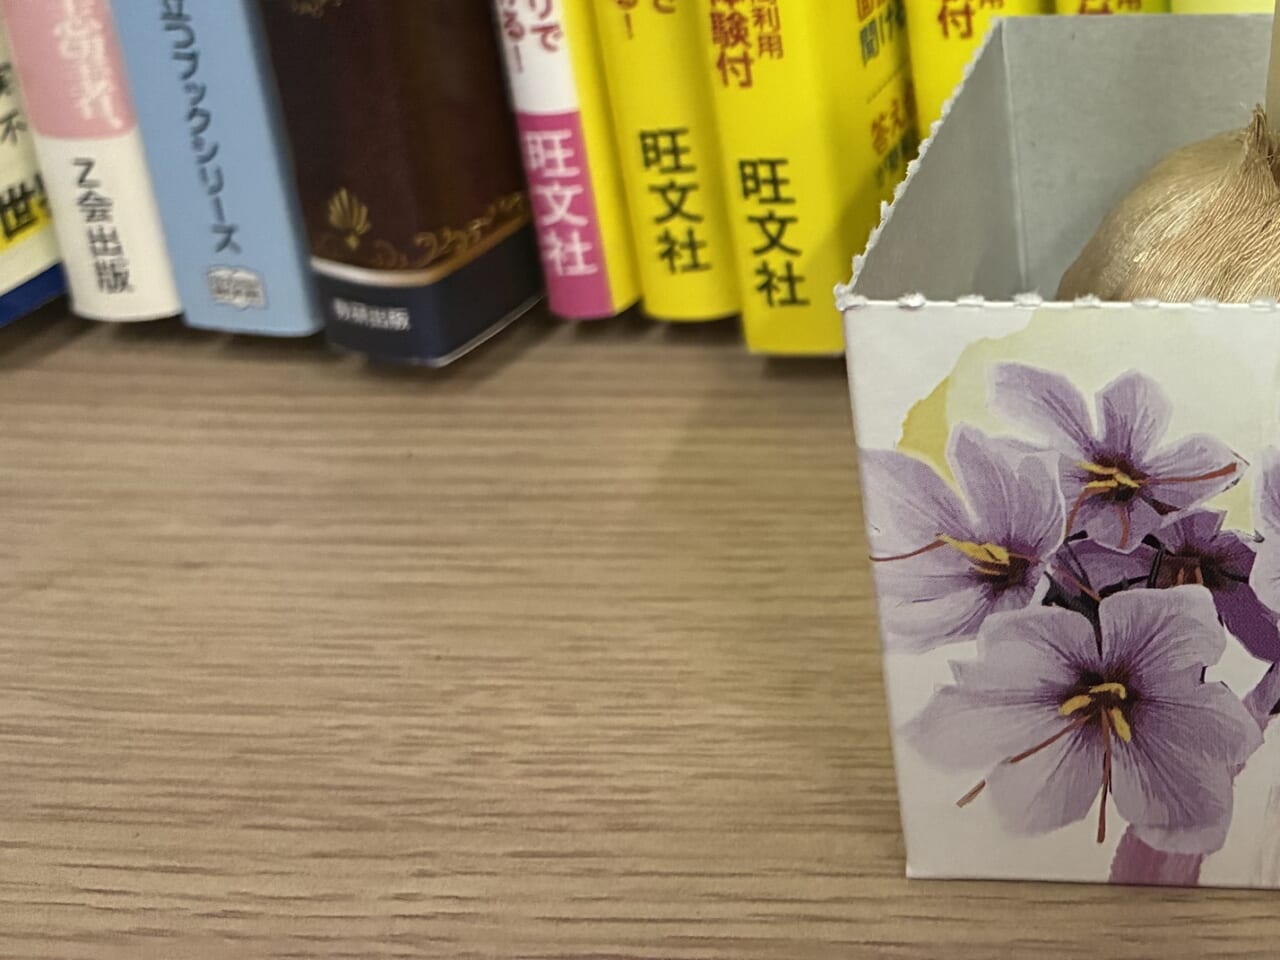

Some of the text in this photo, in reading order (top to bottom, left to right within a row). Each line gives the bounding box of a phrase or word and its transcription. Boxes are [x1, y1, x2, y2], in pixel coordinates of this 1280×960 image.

[73, 158, 134, 295] Z会出版
[524, 129, 599, 277] 旺文社
[639, 127, 712, 274] 旺文社
[739, 157, 810, 308] 旺文社
